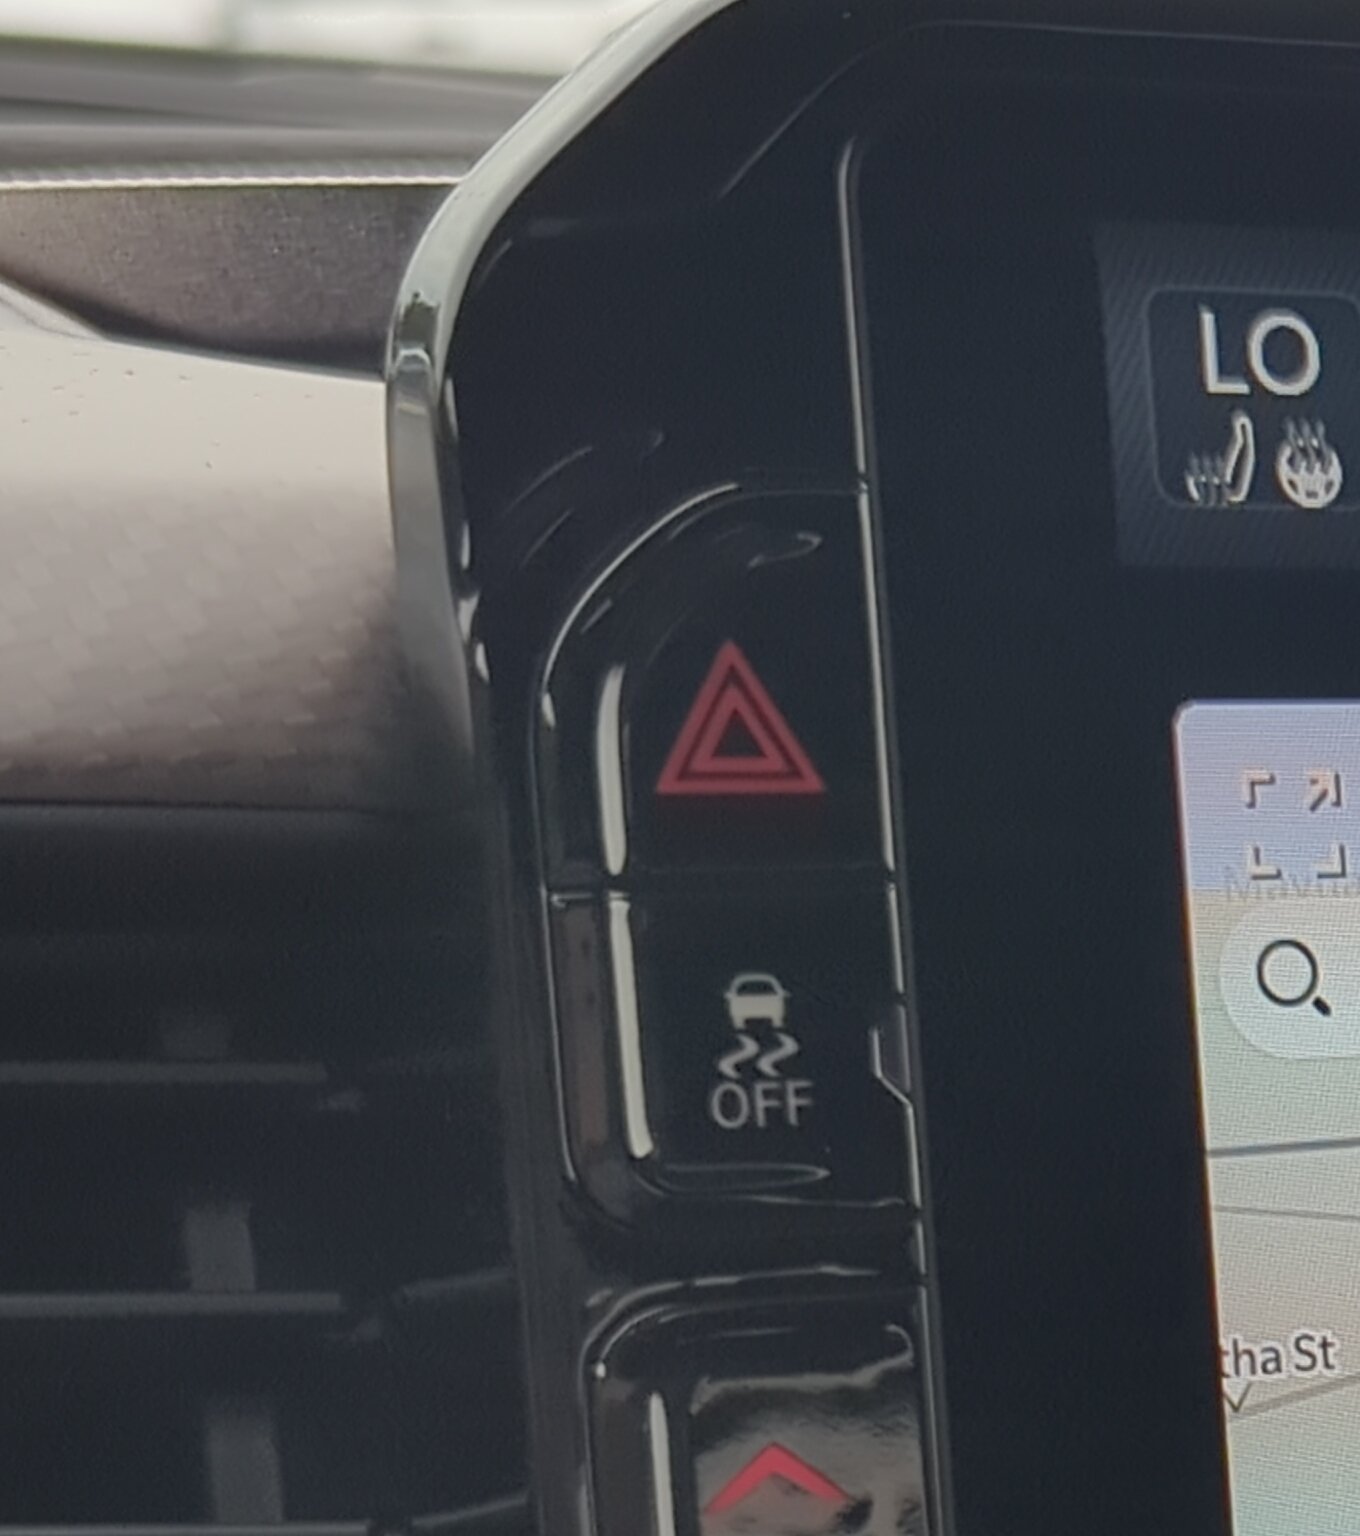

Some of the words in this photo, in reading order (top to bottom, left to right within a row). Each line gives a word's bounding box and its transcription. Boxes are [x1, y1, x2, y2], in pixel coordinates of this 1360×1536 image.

[1199, 305, 1321, 397] LO
[711, 1080, 814, 1129] OFF
[1294, 1333, 1336, 1372] St
